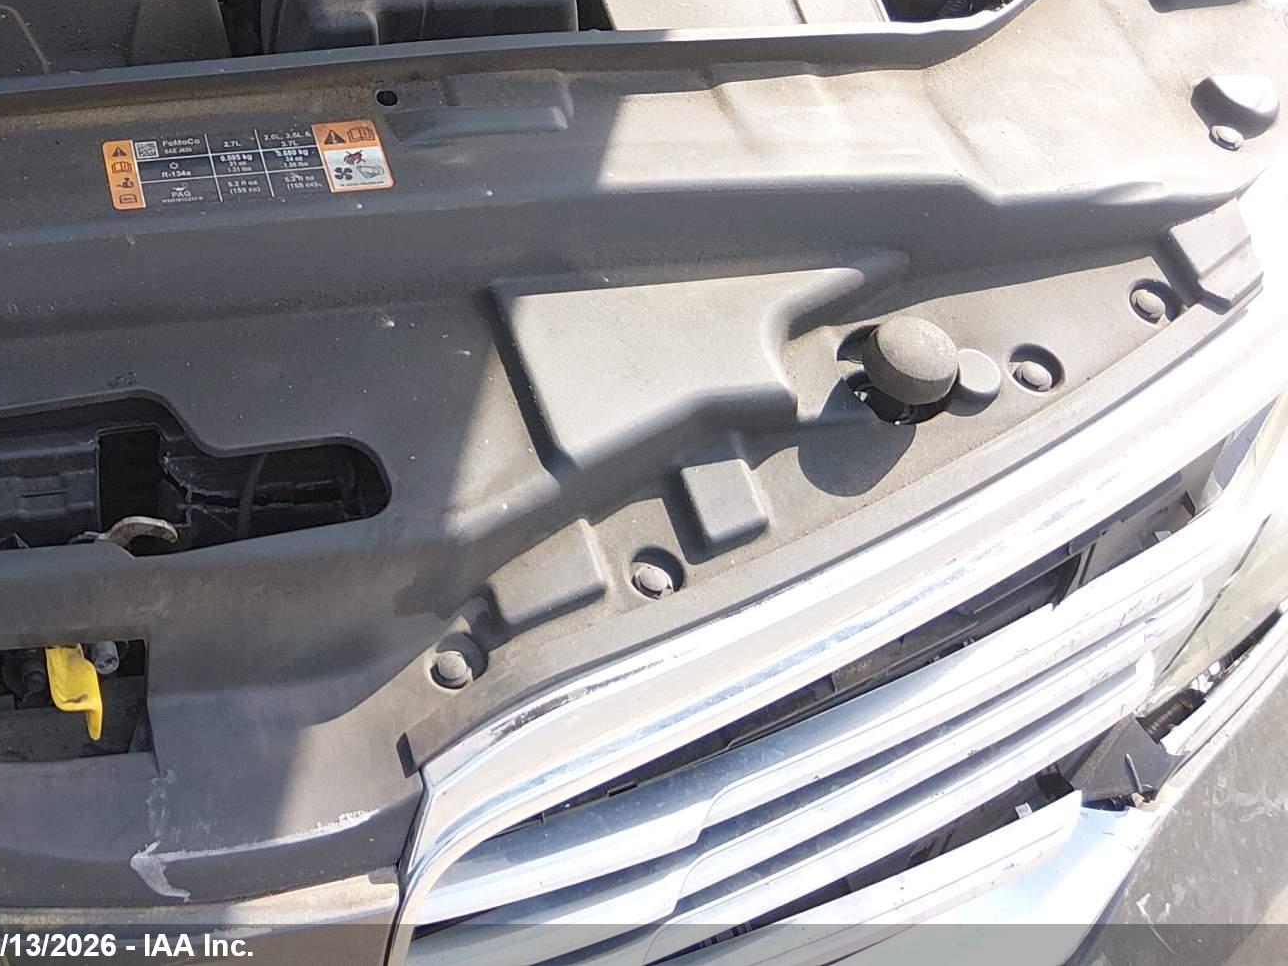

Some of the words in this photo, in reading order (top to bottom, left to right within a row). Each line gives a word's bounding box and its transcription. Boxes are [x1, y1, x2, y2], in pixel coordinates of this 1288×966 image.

[162, 138, 200, 147] FoMoCo
[223, 140, 242, 148] 2.7L
[161, 170, 191, 178] R-134a
[171, 190, 191, 198] PAG
